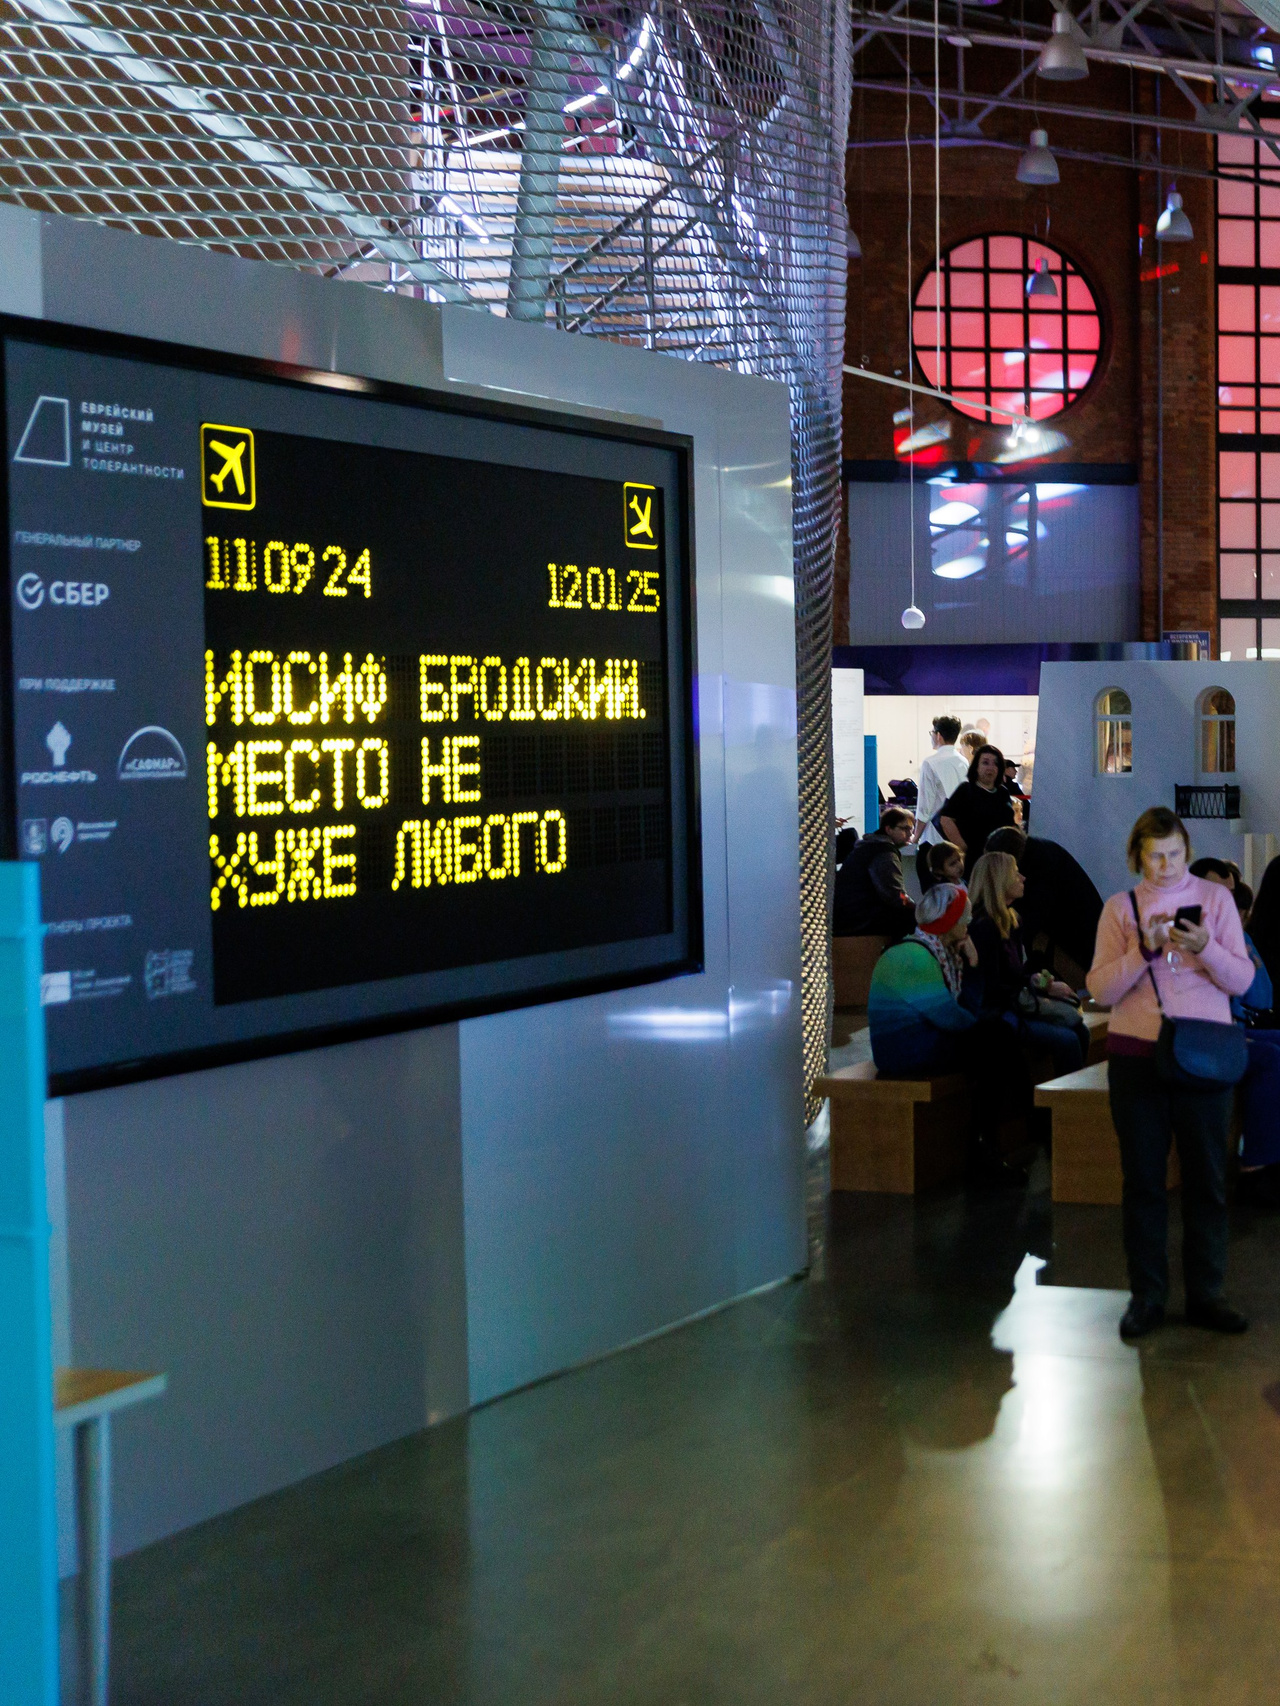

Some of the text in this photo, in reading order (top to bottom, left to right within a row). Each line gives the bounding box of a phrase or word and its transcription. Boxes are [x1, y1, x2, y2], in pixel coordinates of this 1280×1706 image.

[81, 401, 154, 422] ЕВРЕЙСКИЙ
[82, 420, 124, 436] МУЗЕЙ
[82, 439, 134, 455] И ЦЕНТР
[83, 457, 184, 479] ТОЛЕРАНТНОСТИ
[15, 531, 141, 551] ГЕНЕРАЛЬНЫЙ ПАРТНЕР
[50, 580, 110, 606] СБЕР
[204, 650, 387, 726] ИОСИФ
[206, 736, 481, 818] МЕСТО НЕ
[209, 809, 567, 911] ХУЖЕ ЛЮБОГО
